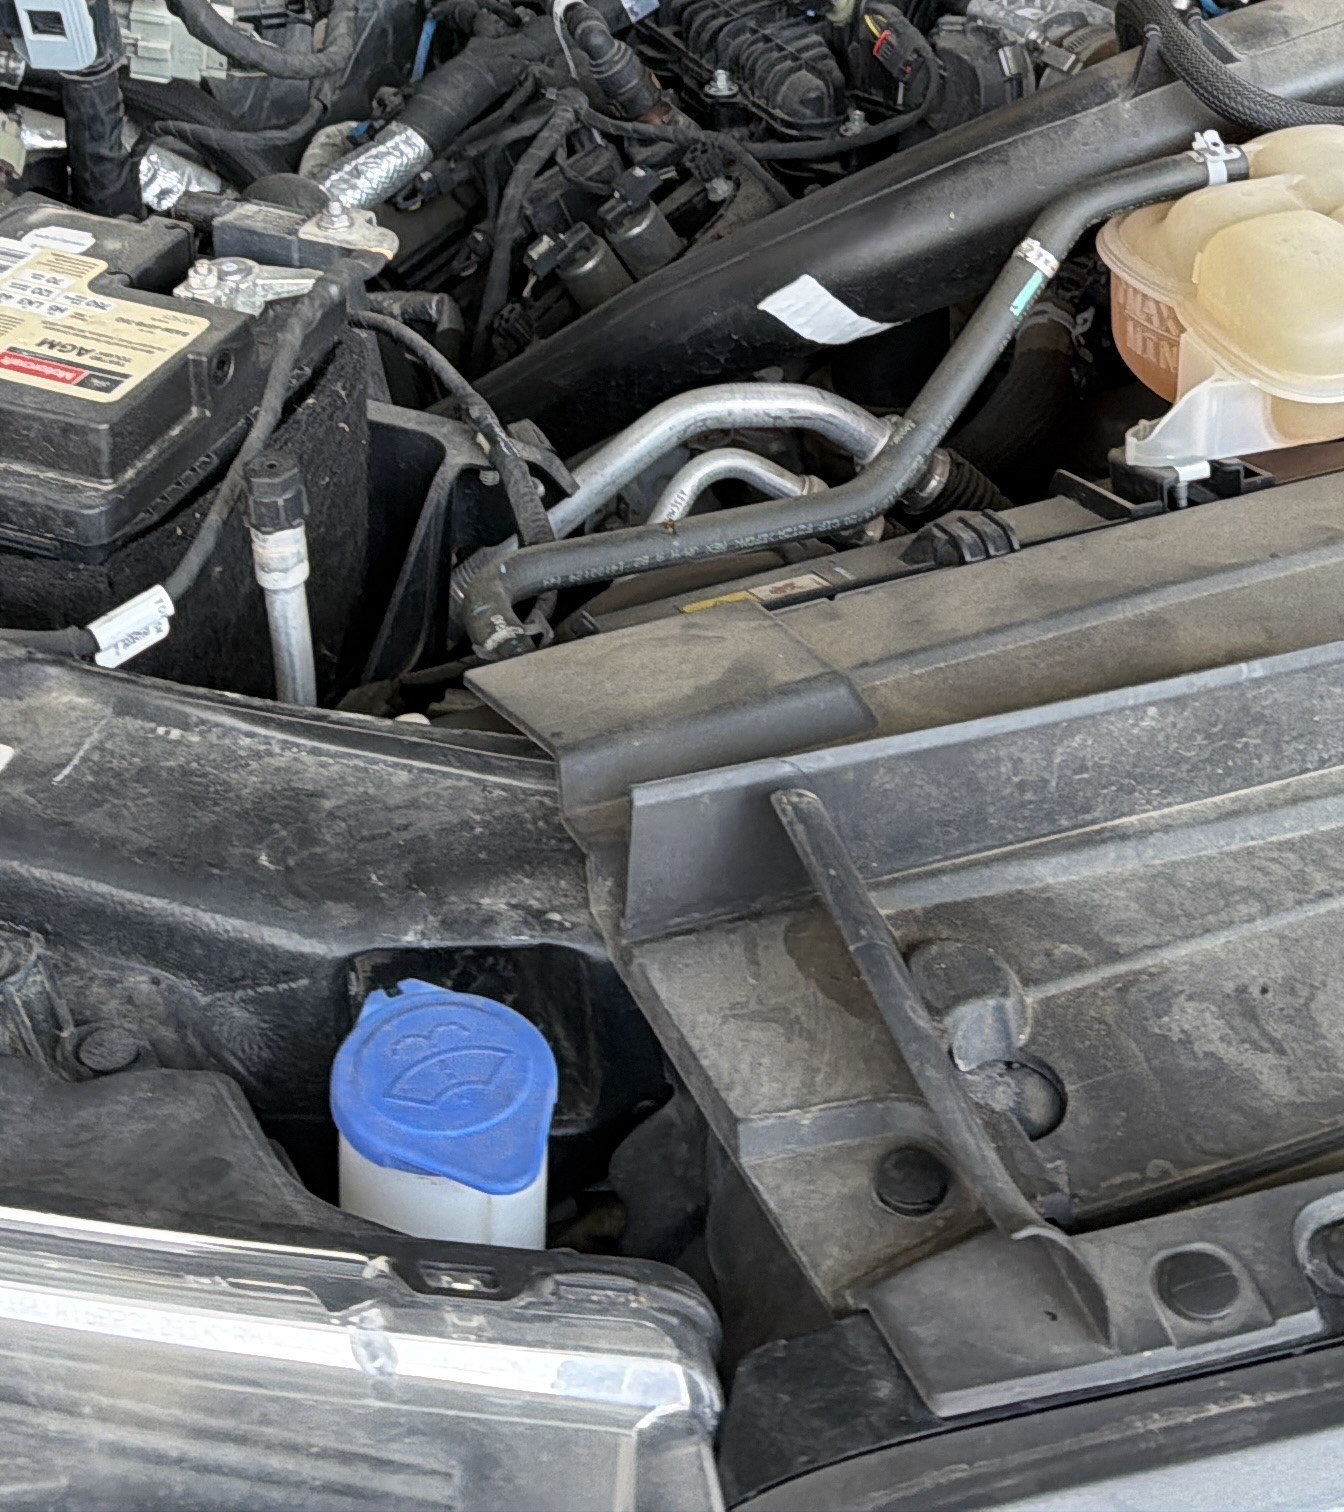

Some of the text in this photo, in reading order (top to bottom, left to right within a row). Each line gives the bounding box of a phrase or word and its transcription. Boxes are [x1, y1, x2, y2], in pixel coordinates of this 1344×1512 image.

[1118, 282, 1178, 338] MAX
[35, 338, 96, 357] AGM
[1126, 320, 1179, 373] MIN
